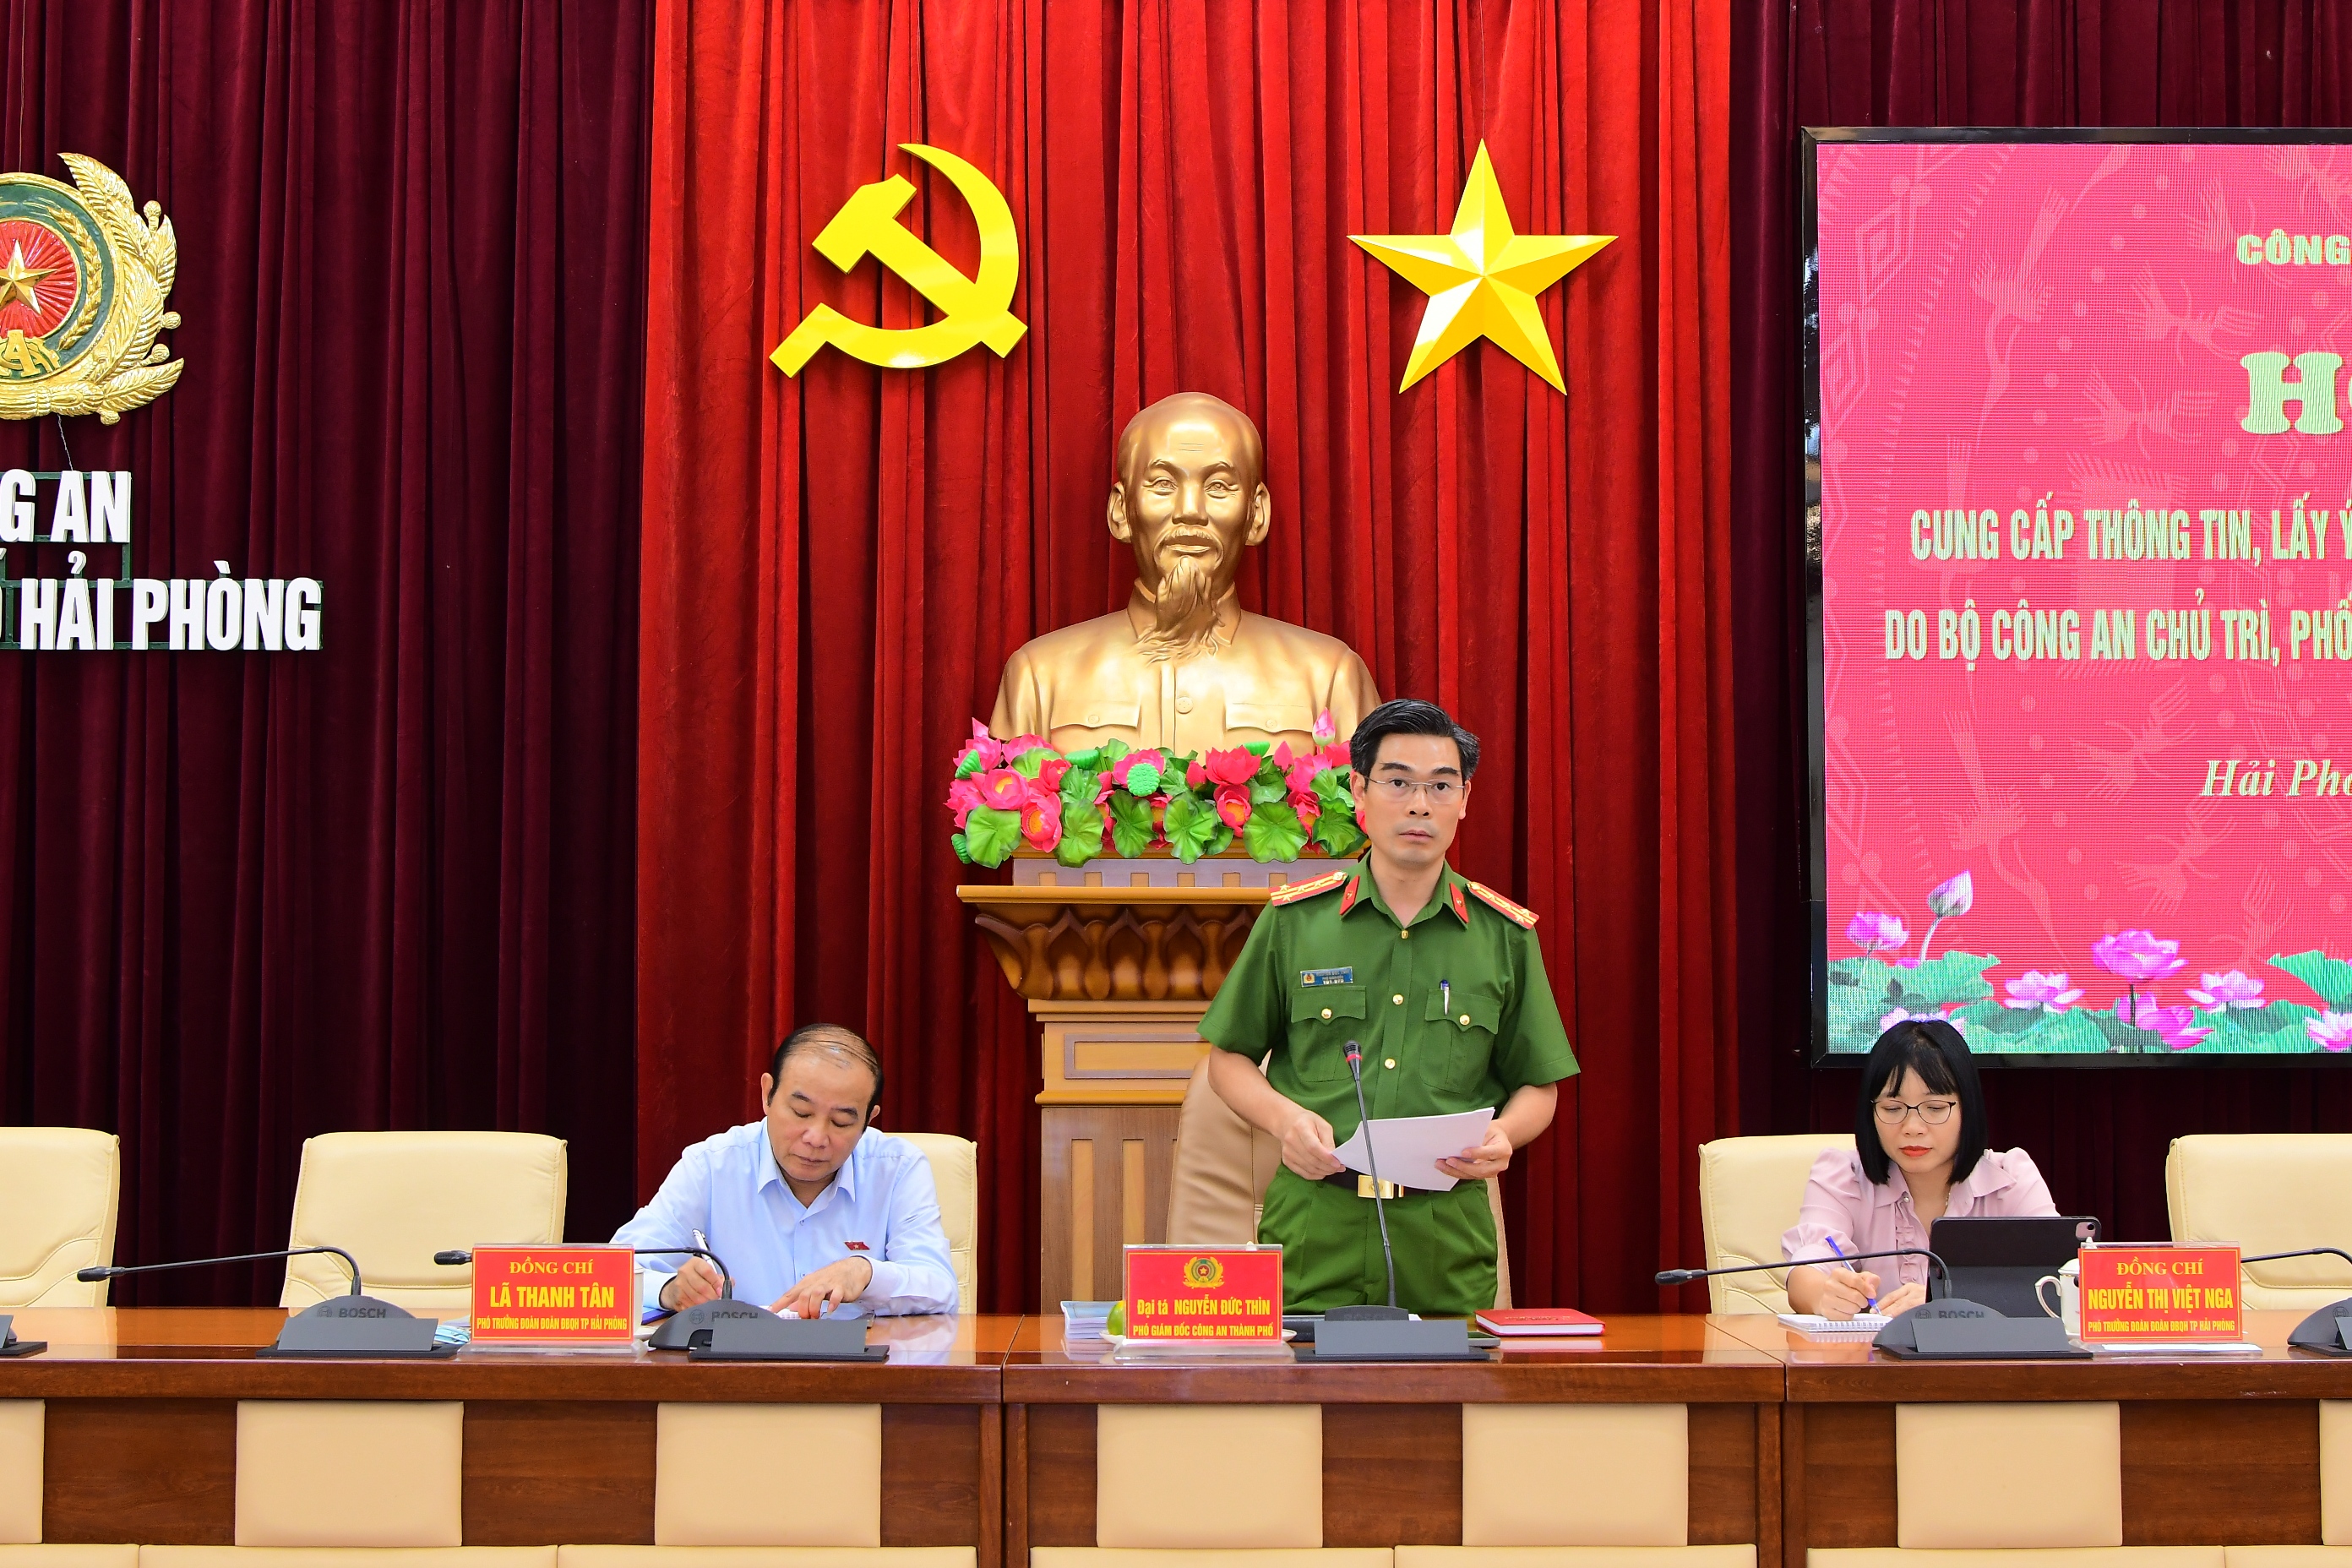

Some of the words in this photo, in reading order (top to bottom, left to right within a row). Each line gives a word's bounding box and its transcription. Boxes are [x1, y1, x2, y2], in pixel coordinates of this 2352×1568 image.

[2236, 228, 2351, 265] CÔNG
[2240, 351, 2352, 435] H
[50, 470, 132, 543] AN
[1911, 509, 1999, 560] CUNG
[2011, 492, 2074, 559] CẤP
[2083, 498, 2190, 561] THÔNG
[2200, 509, 2262, 567] TIN,
[2272, 492, 2329, 560] LẤY
[20, 550, 114, 650] HẢI
[132, 561, 322, 651] PHÒNG
[1885, 610, 1927, 660] DO
[1938, 599, 1980, 671] BỘ
[1992, 599, 2081, 661] CÔNG
[2091, 610, 2136, 660] AN
[2146, 588, 2211, 661] CHỦ
[2220, 599, 2280, 667] TRÌ,
[2199, 760, 2276, 797] Hải
[509, 1256, 558, 1274] ĐỒNG
[563, 1259, 594, 1274] CHÍ
[2117, 1256, 2168, 1275] ĐỒNG
[2172, 1259, 2203, 1275] CHÍ
[490, 1282, 511, 1308] LÃ
[517, 1286, 574, 1308] THANH
[580, 1282, 614, 1308] TÂN
[1137, 1299, 1155, 1318] Đại
[1157, 1299, 1168, 1315] tá
[1174, 1294, 1218, 1315] NGUYỄN
[1221, 1297, 1243, 1315] ĐỨC
[1245, 1297, 1270, 1315] THÌN
[2088, 1282, 2143, 1310] NGUYỄN
[2147, 1288, 2169, 1314] THỊ
[2171, 1284, 2201, 1314] VIỆT
[2205, 1288, 2234, 1309] NGA
[339, 1307, 386, 1319] BOSCH
[561, 1318, 580, 1331] ĐBQH
[580, 1318, 590, 1330] TP
[1938, 1310, 1984, 1319] BOSCH
[2170, 1320, 2188, 1332] ĐBQH
[2190, 1320, 2198, 1331] TP
[1133, 1323, 1149, 1337] PHÓ
[1152, 1323, 1172, 1337] GIÁM
[1173, 1321, 1190, 1337] ĐỐC
[1192, 1323, 1214, 1337] CÔNG
[1216, 1326, 1228, 1337] AN
[1229, 1323, 1255, 1337] THÀNH
[1257, 1321, 1273, 1337] PHỐ
